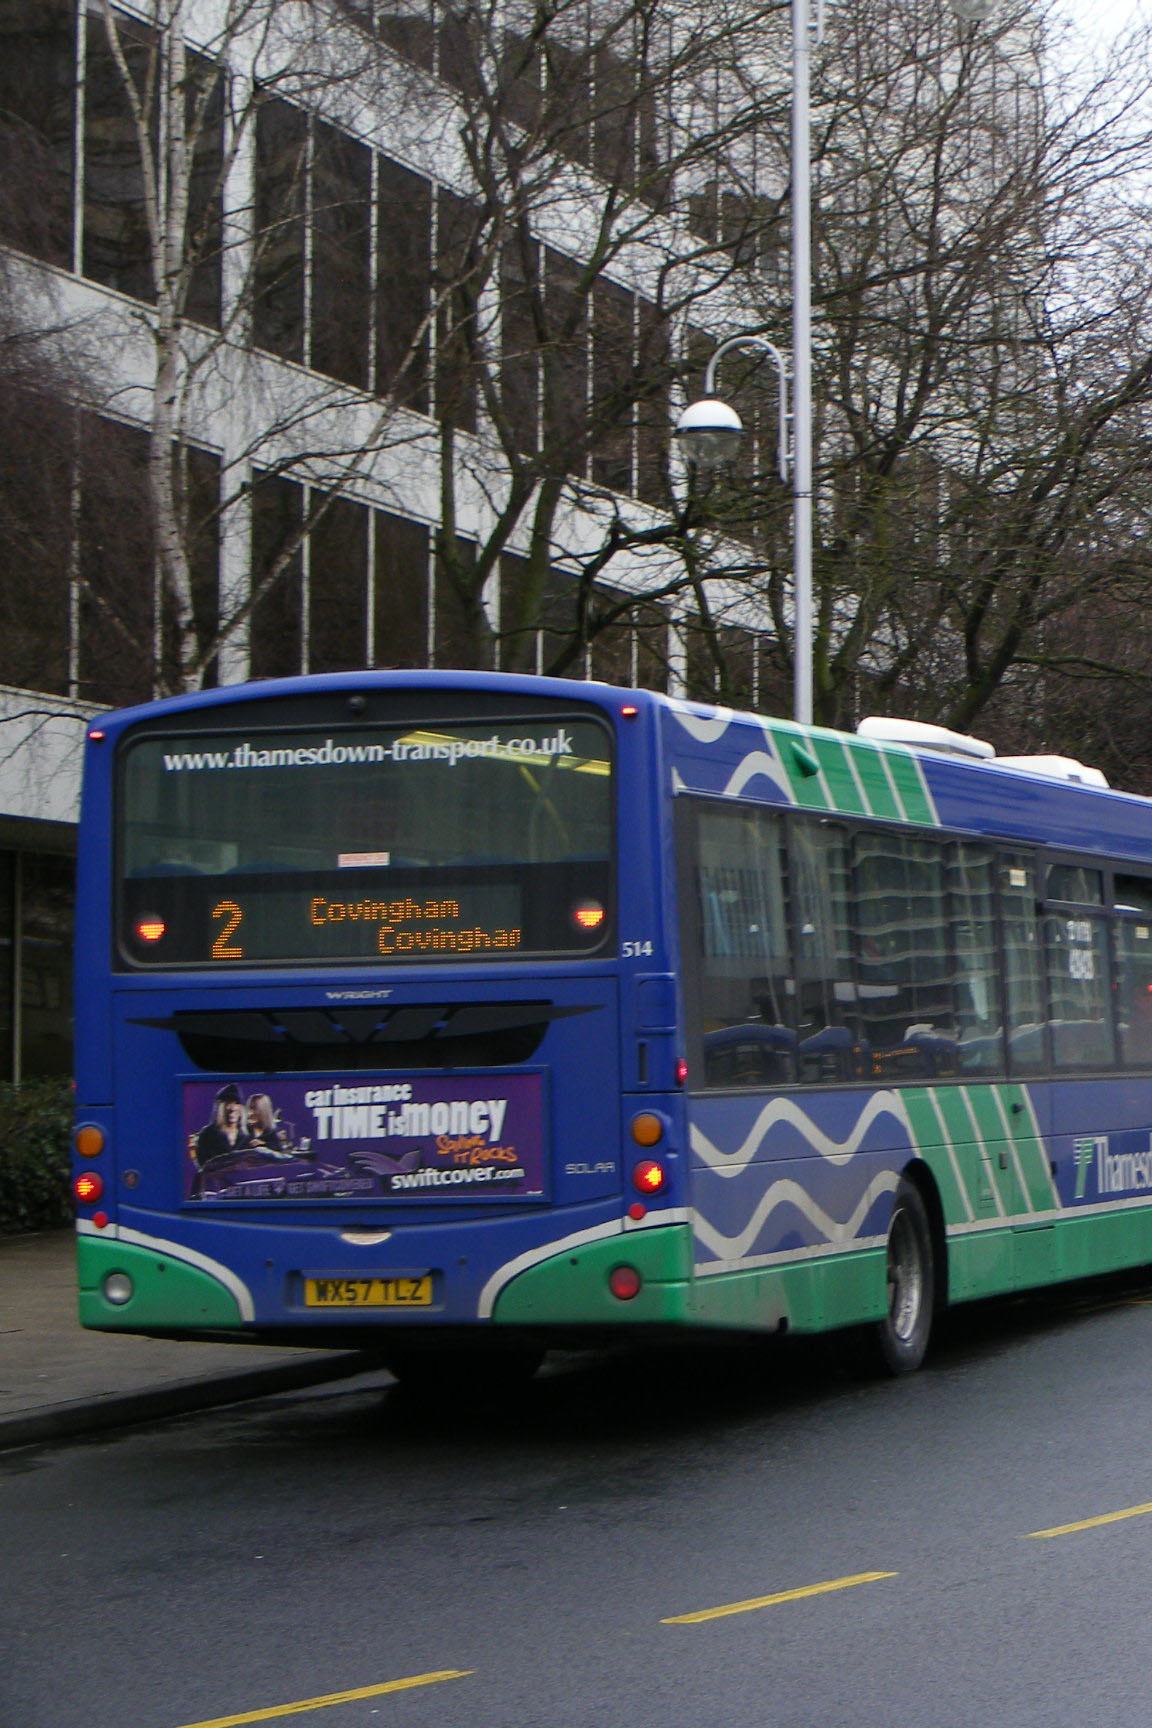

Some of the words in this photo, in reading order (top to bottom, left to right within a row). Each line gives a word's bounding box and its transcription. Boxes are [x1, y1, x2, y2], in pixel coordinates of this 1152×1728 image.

[164, 729, 574, 772] www.thamesdown-transport.co.uk
[310, 897, 460, 924] Covingham
[211, 899, 243, 959] 2
[622, 940, 653, 959] 514
[325, 989, 394, 999] WRIGHT
[304, 1088, 332, 1108] car
[333, 1083, 412, 1106] insurance
[313, 1104, 387, 1140] TIME
[388, 1110, 405, 1136] is
[391, 1166, 525, 1190] swiftcover.com
[316, 1280, 373, 1303] WX57
[380, 1279, 422, 1302] TLZ
